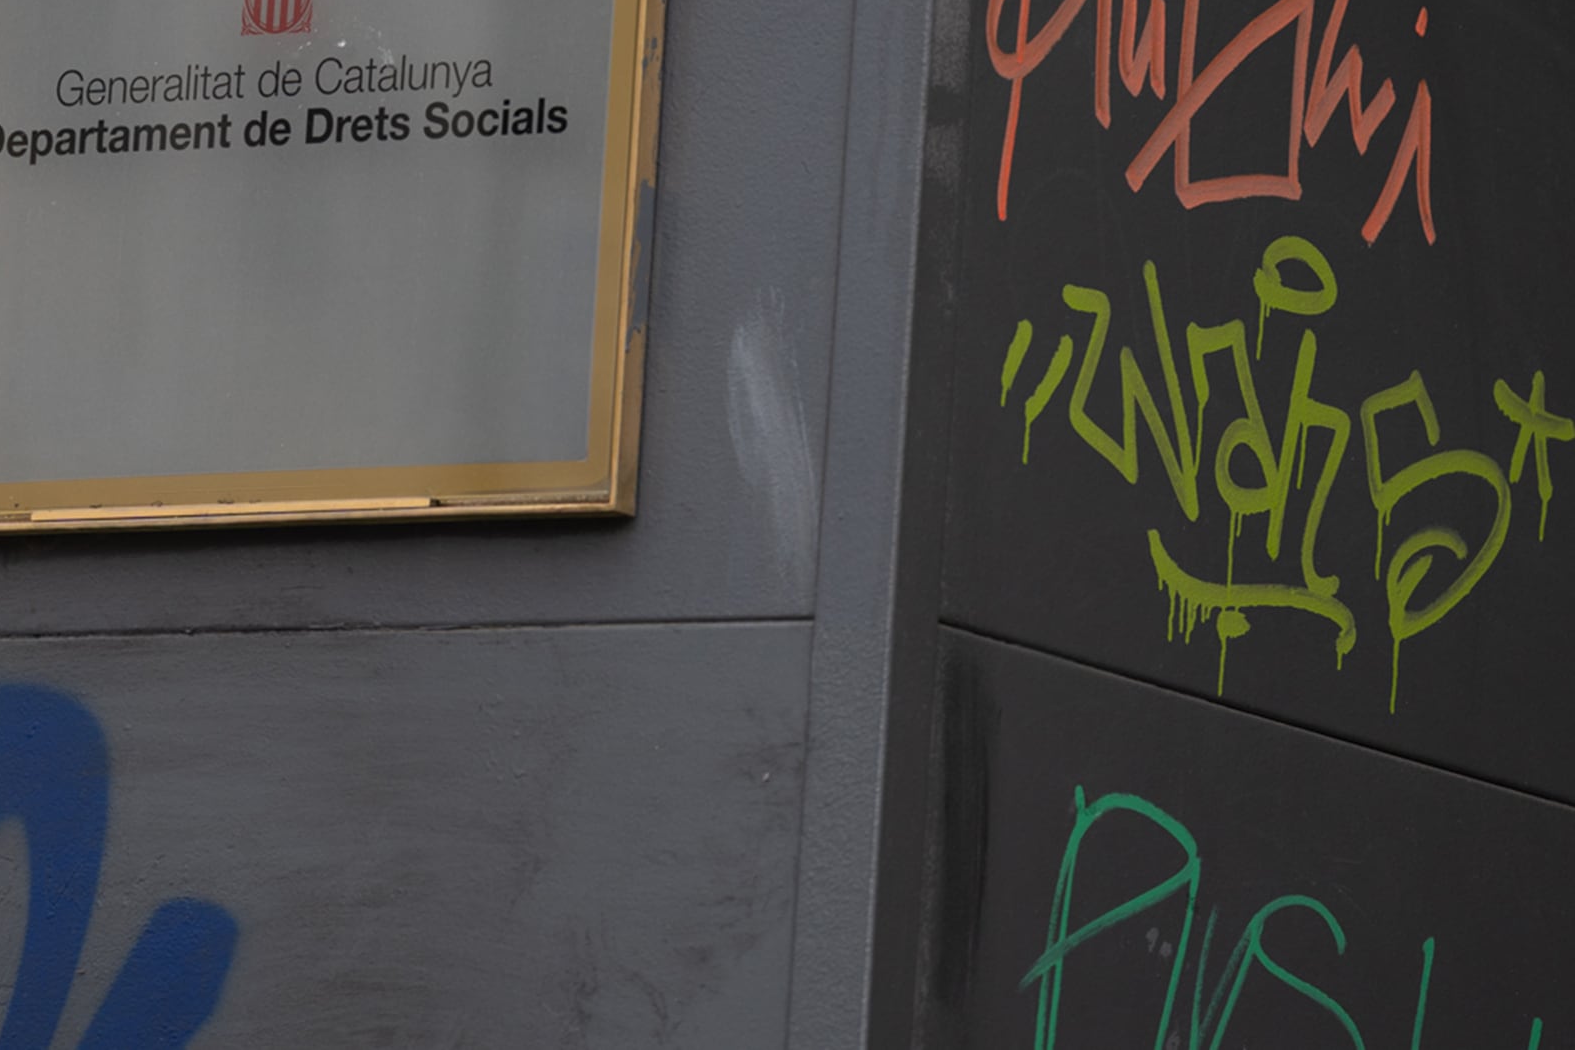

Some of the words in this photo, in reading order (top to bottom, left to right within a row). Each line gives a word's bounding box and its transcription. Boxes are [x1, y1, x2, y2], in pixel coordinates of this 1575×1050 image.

[56, 64, 245, 108] Generalitat
[257, 60, 302, 99] de
[314, 54, 493, 98] Catalunya
[243, 110, 291, 147] de
[304, 104, 411, 145] Drets
[423, 97, 569, 140] Socials
